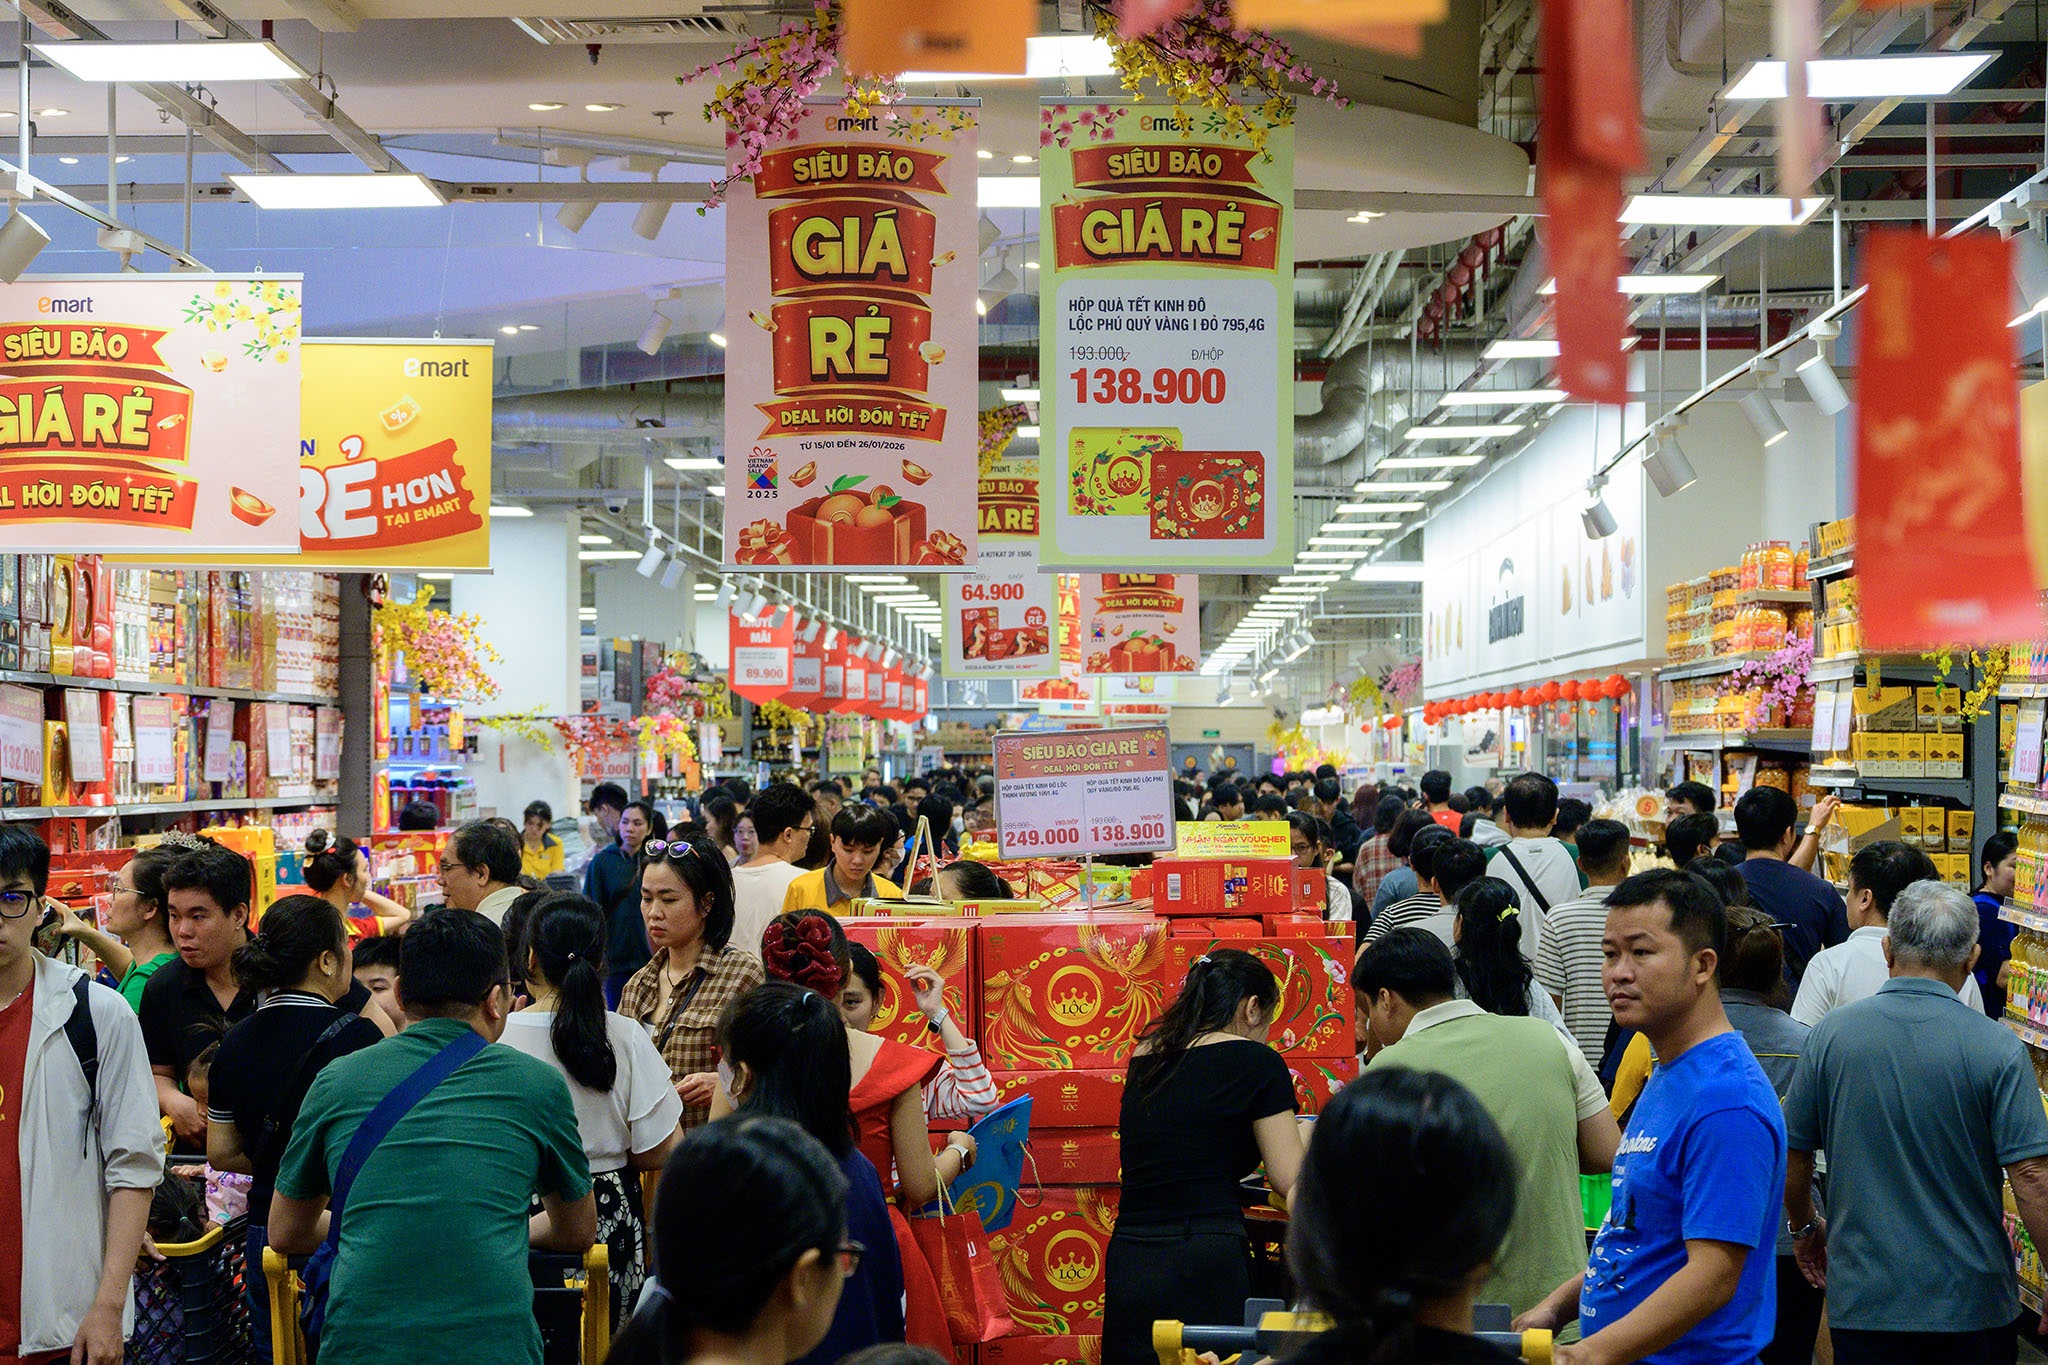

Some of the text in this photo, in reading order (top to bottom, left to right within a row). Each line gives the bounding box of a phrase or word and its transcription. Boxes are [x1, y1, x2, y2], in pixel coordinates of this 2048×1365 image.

[824, 115, 879, 132] emart
[792, 150, 914, 182] SIÊU BÃO
[1107, 146, 1223, 177] SIÊU BÃO
[1081, 200, 1246, 260] GIÁ RẺ
[791, 208, 909, 282] GIÁ
[38, 296, 93, 313] emart
[1068, 295, 1206, 314] HỘP QUÀ TẾT KINH ĐÔ
[1068, 313, 1094, 334] LỘC
[1097, 315, 1123, 331] PHÚ
[1126, 315, 1151, 332] QUÝ
[1155, 315, 1189, 331] VÀNG
[1200, 314, 1219, 331] ĐỎ
[1222, 318, 1265, 333] 795,4G
[4, 326, 129, 360] SIÊU BÃO
[808, 305, 892, 382] RẺ
[1069, 346, 1224, 363] 193.000 Đ/HỘP
[404, 358, 469, 377] emart
[1070, 367, 1227, 405] 138.900
[82, 386, 153, 450] RẺ
[780, 405, 930, 431] DEAL HỜI ĐÓN TẾT
[800, 438, 905, 451] TỪ 15/01 ĐẾN 26/01/2026
[22, 479, 62, 508] HỜI
[69, 480, 121, 509] ĐÓN
[128, 484, 174, 514] TẾT
[382, 469, 456, 509] HƠN
[384, 497, 461, 528] TẠI EMART
[1005, 504, 1035, 531] RẺ
[961, 583, 1024, 601] 64.900
[746, 668, 784, 679] 89.900
[1056, 741, 1088, 759] BÃO
[1043, 765, 1063, 774] DEAL
[1005, 828, 1080, 847] 249.000
[1091, 823, 1165, 842] 138.900
[1240, 835, 1287, 843] VOUCHER
[1061, 999, 1089, 1017] LỘC
[1059, 1264, 1087, 1281] LỘC
